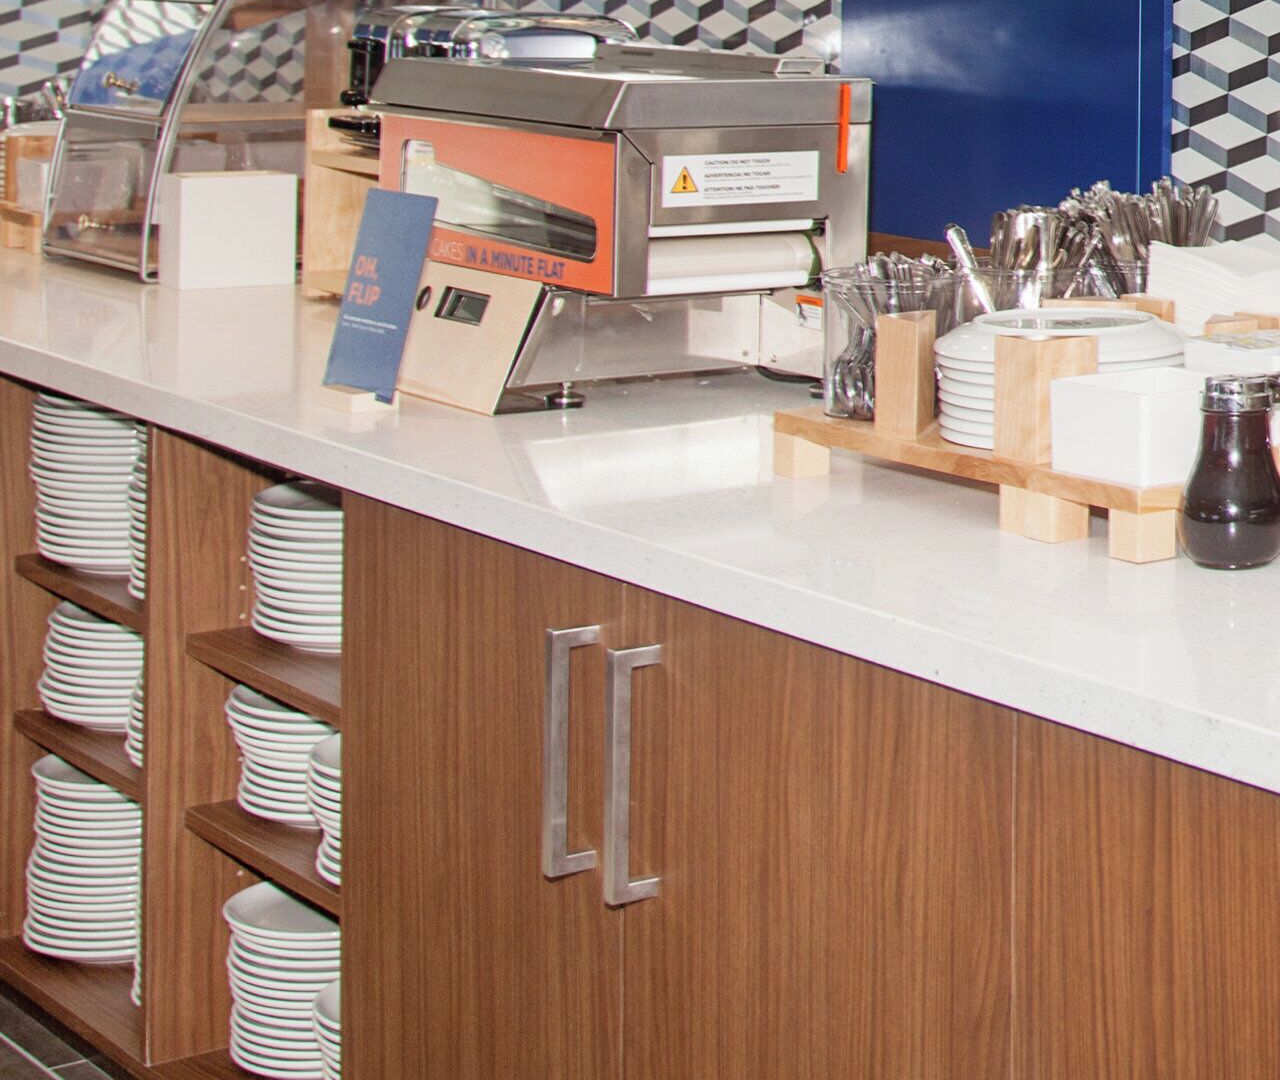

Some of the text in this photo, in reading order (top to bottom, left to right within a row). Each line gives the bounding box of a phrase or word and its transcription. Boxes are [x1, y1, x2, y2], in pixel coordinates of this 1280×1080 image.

[431, 238, 566, 279] CAKES IN A MINUTE FLAT
[348, 281, 381, 308] FLIP
